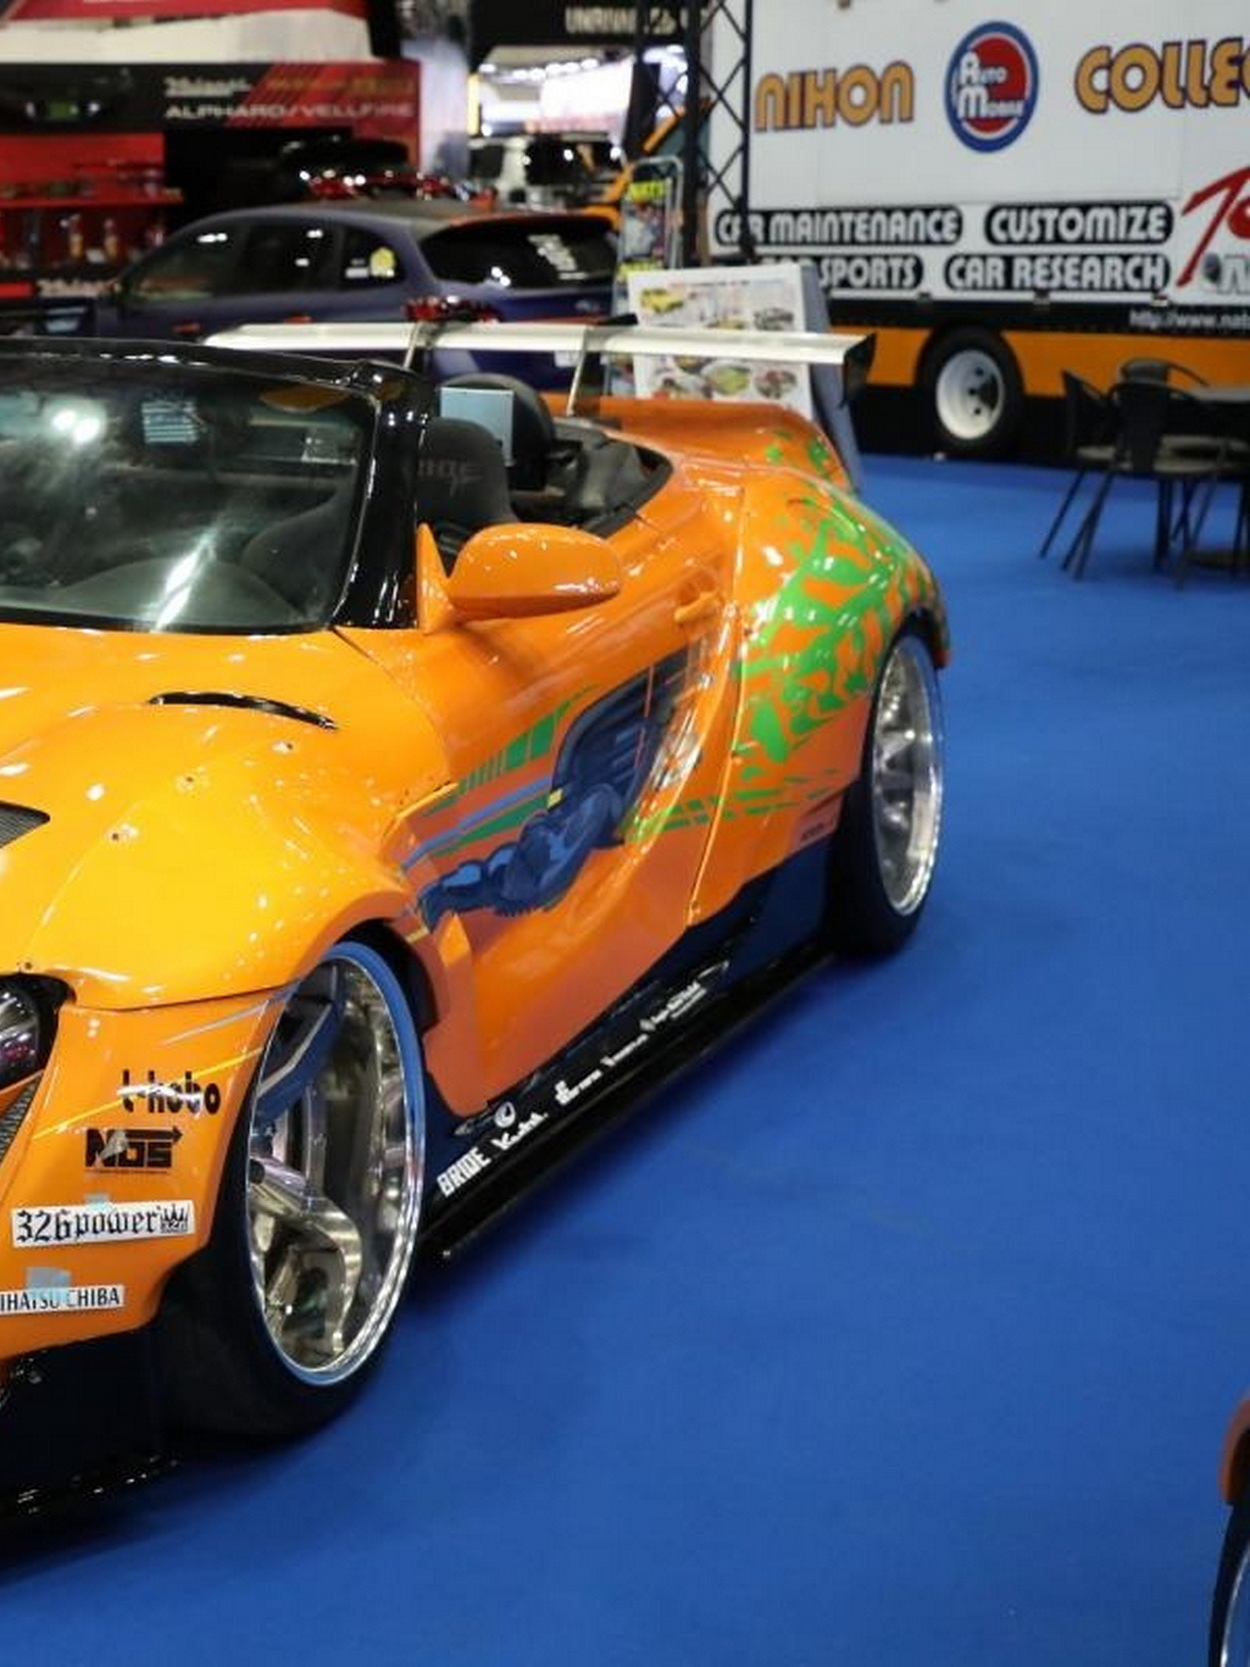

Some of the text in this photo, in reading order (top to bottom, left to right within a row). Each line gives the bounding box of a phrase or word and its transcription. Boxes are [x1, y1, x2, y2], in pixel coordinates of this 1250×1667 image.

[754, 59, 915, 133] NIHON
[769, 209, 959, 243] MAINTENANCE
[990, 206, 1167, 243] CUSTOMIZE
[949, 254, 1166, 291] CAR RESEARCH
[84, 1128, 174, 1168] NOS
[436, 1146, 491, 1198] BRIDE
[15, 1204, 161, 1244] 326power
[66, 1287, 121, 1308] CHIBA
